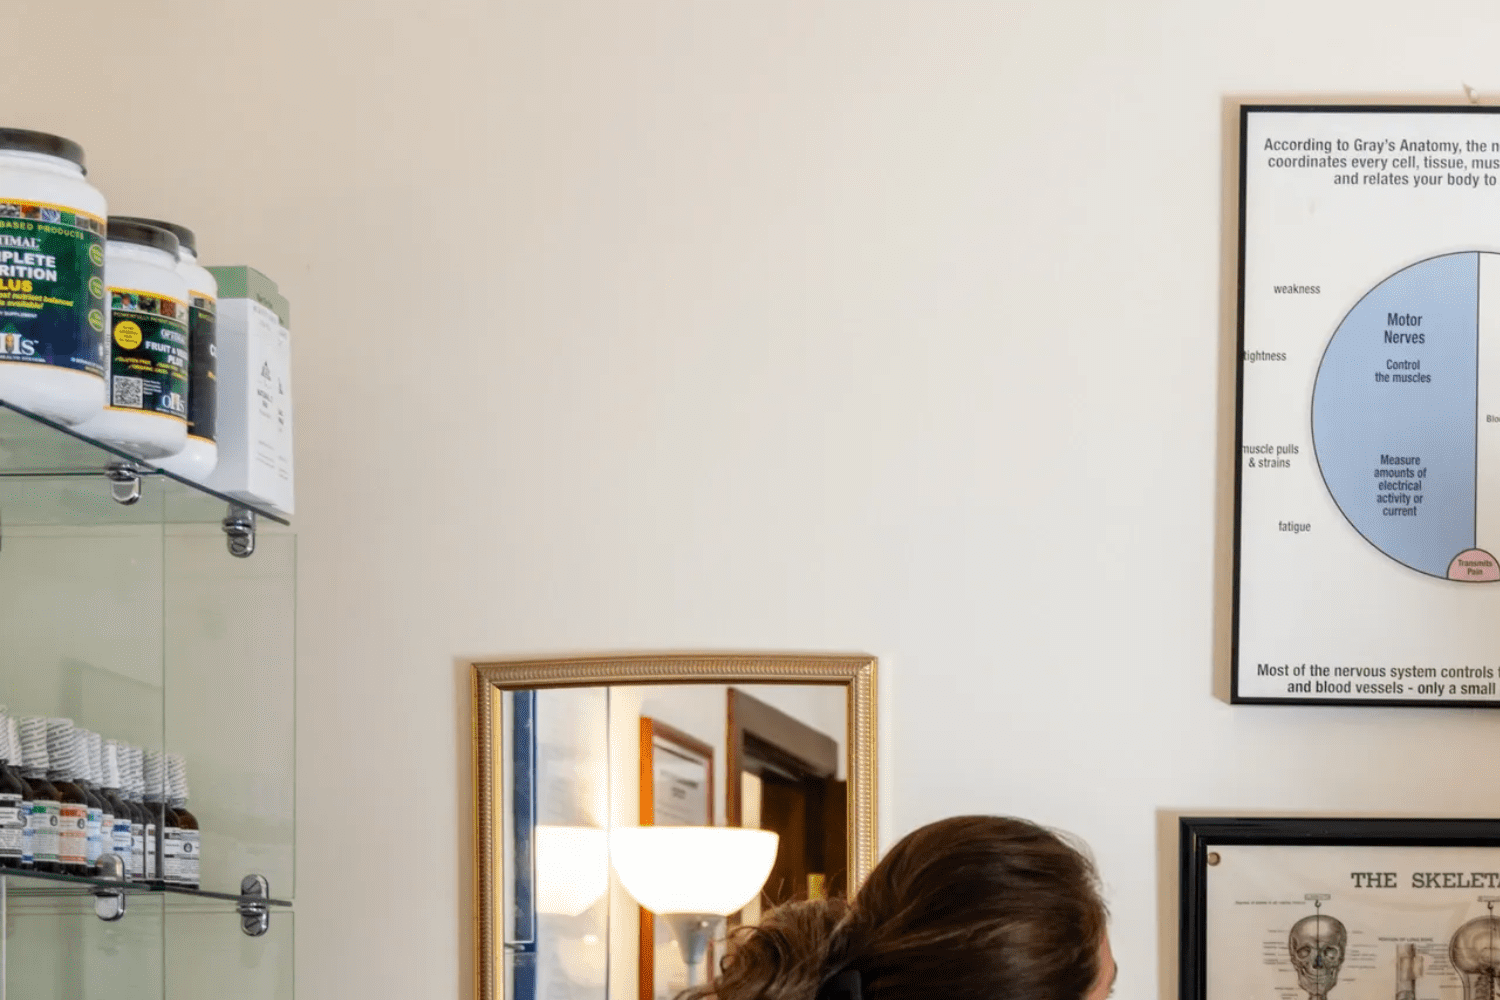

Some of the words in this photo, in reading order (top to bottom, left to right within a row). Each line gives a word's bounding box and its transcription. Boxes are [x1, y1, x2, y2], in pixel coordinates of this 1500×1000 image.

[1264, 138, 1331, 153] According
[1336, 138, 1348, 151] to
[1354, 138, 1394, 154] Gray's
[1400, 139, 1460, 154] Anatomy,
[1466, 139, 1486, 151] the
[1268, 155, 1346, 167] coordinates
[1351, 158, 1387, 170] every
[1392, 155, 1418, 169] cell,
[1424, 155, 1466, 169] tissue,
[1334, 172, 1358, 184] and
[1363, 172, 1408, 184] relates
[1414, 175, 1442, 187] your
[1447, 172, 1478, 187] body
[1484, 173, 1496, 185] to
[38, 225, 84, 240] PRODUCTS
[0, 251, 56, 267] PLETE
[1273, 283, 1320, 293] weakness
[1387, 312, 1422, 326] Motor
[1384, 330, 1424, 343] Nerves
[1244, 350, 1287, 363] tightness
[1386, 359, 1420, 370] Control
[1374, 372, 1389, 382] the
[1392, 372, 1430, 383] muscles
[1242, 444, 1274, 454] muscle
[1277, 444, 1299, 456] pulls
[1248, 457, 1256, 468] &
[1258, 457, 1291, 468] strains
[1380, 454, 1420, 465] Measure
[1374, 467, 1414, 478] amounts
[1417, 467, 1426, 478] of
[1378, 480, 1421, 491] electrical
[1377, 492, 1409, 505] activity
[1414, 495, 1423, 503] or
[1382, 505, 1416, 516] current
[1278, 521, 1310, 533] fatigue
[1458, 559, 1492, 567] Transmits
[1256, 664, 1288, 675] Most
[1293, 663, 1304, 675] of
[1310, 664, 1329, 676] the
[1334, 667, 1385, 676] nervous
[1390, 665, 1436, 680] system
[1440, 665, 1493, 678] controls
[1287, 680, 1310, 692] and
[1316, 680, 1350, 692] blood
[1356, 681, 1402, 693] vessels
[1418, 681, 1444, 696] only
[1449, 684, 1455, 693] a
[1461, 682, 1494, 694] small
[1349, 870, 1396, 887] THE
